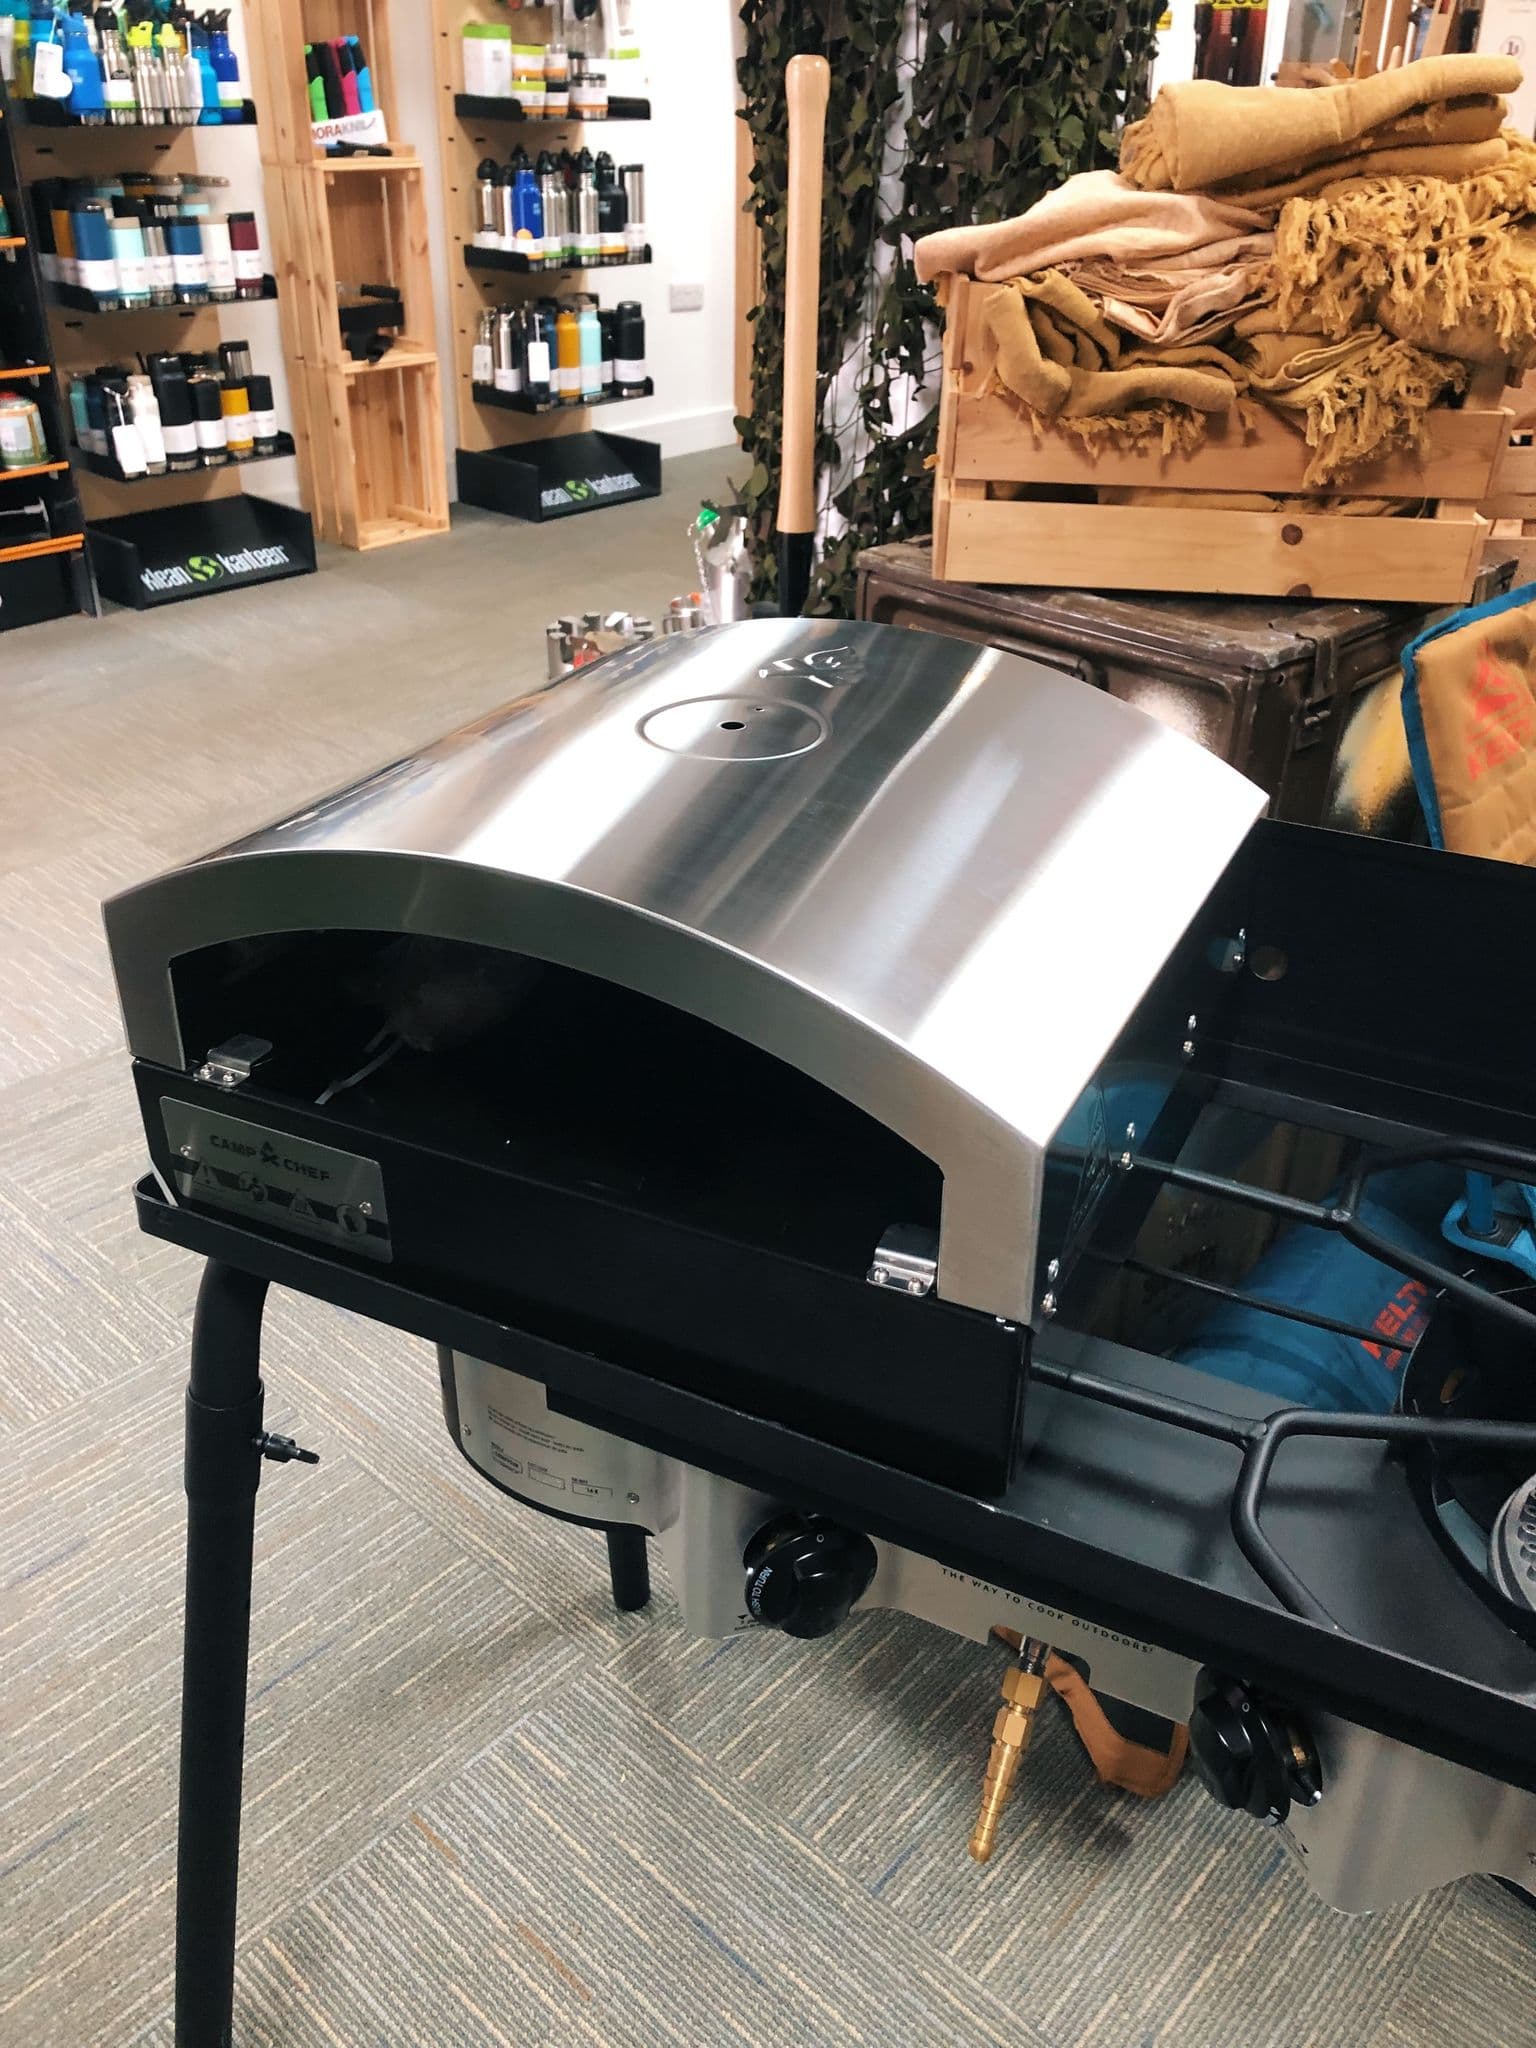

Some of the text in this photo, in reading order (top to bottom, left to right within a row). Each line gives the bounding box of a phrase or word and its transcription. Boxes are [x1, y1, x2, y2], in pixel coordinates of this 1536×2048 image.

[140, 546, 290, 591] klean kanteen
[283, 1159, 331, 1181] CHEF
[755, 1566, 774, 1588] TURN
[752, 1585, 763, 1599] TO
[941, 1567, 965, 1582] THE
[972, 1579, 999, 1595] WAY
[1005, 1592, 1021, 1605] TO
[1027, 1601, 1065, 1621] COOK
